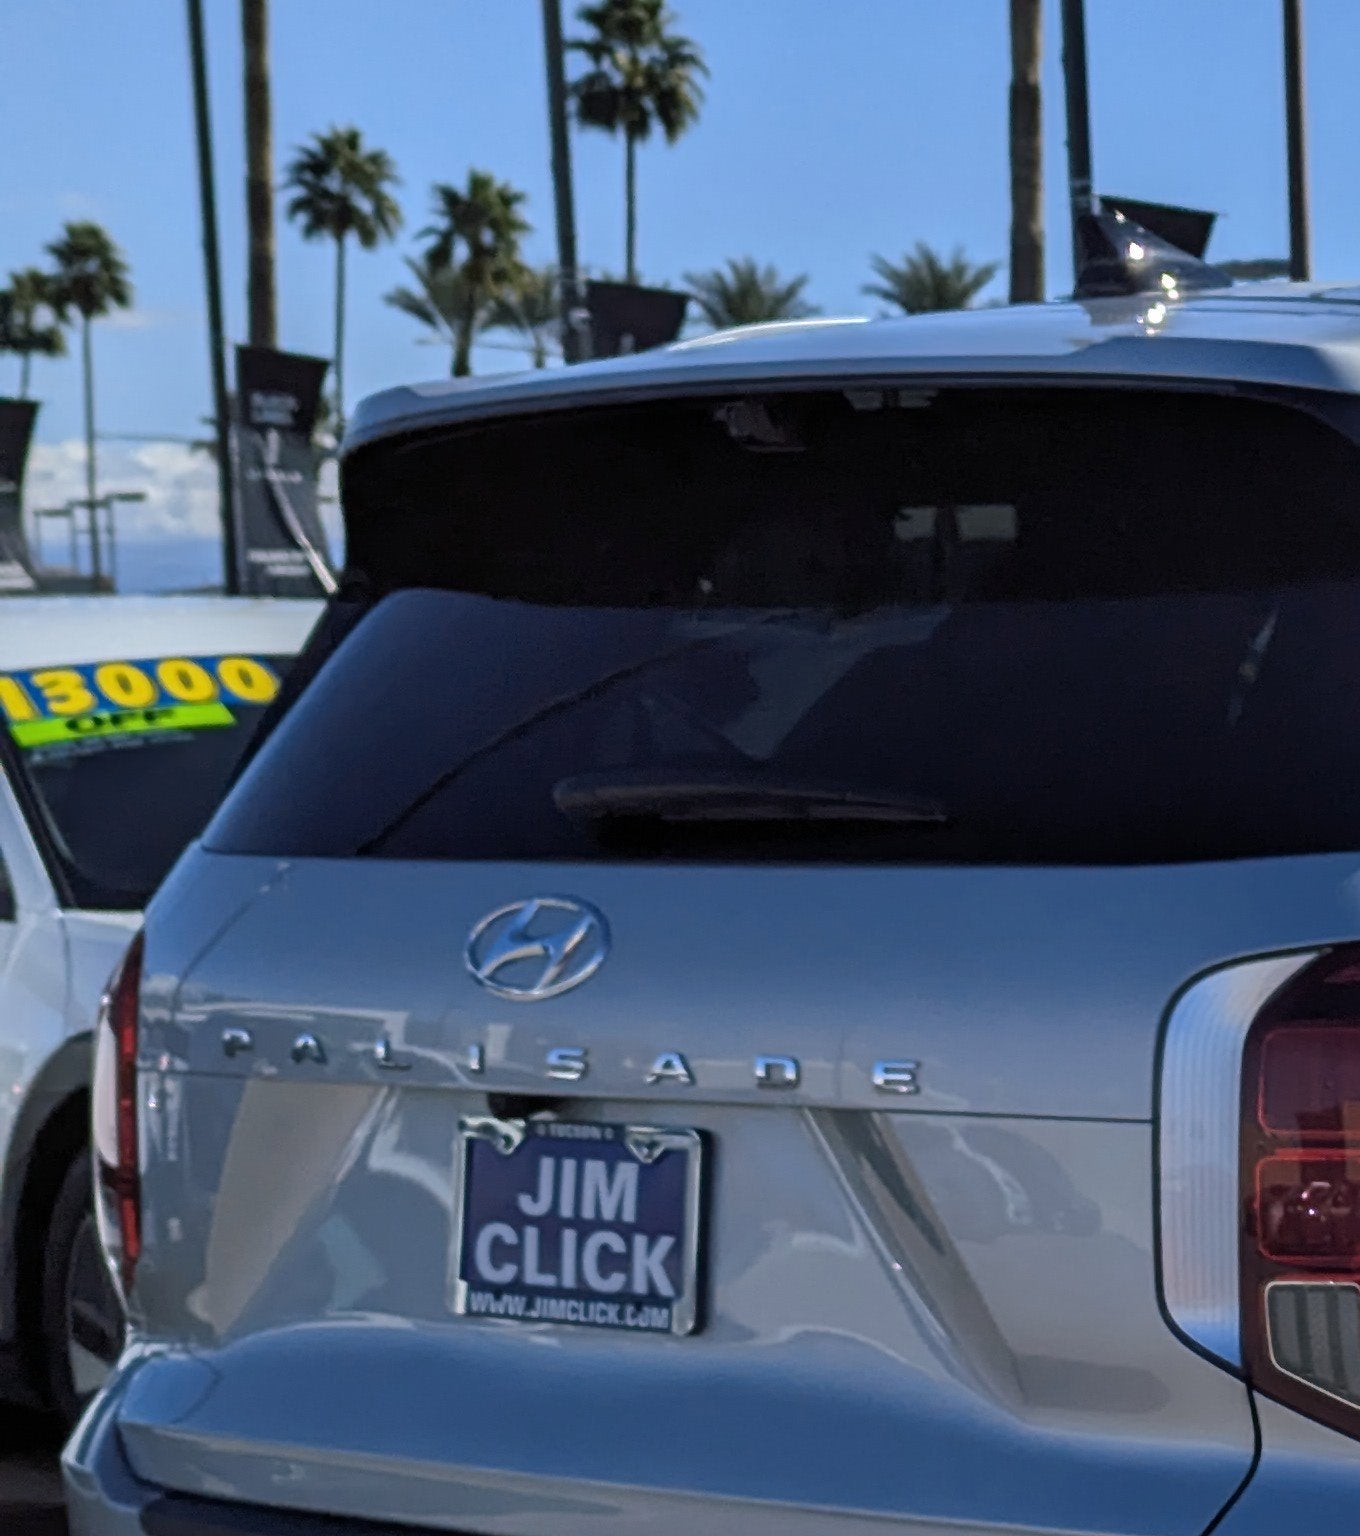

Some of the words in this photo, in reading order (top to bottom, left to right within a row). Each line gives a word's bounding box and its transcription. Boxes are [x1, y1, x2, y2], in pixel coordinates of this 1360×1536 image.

[222, 1027, 921, 1094] PALISADE
[518, 1156, 639, 1223] JIM
[474, 1222, 676, 1297] CLICK
